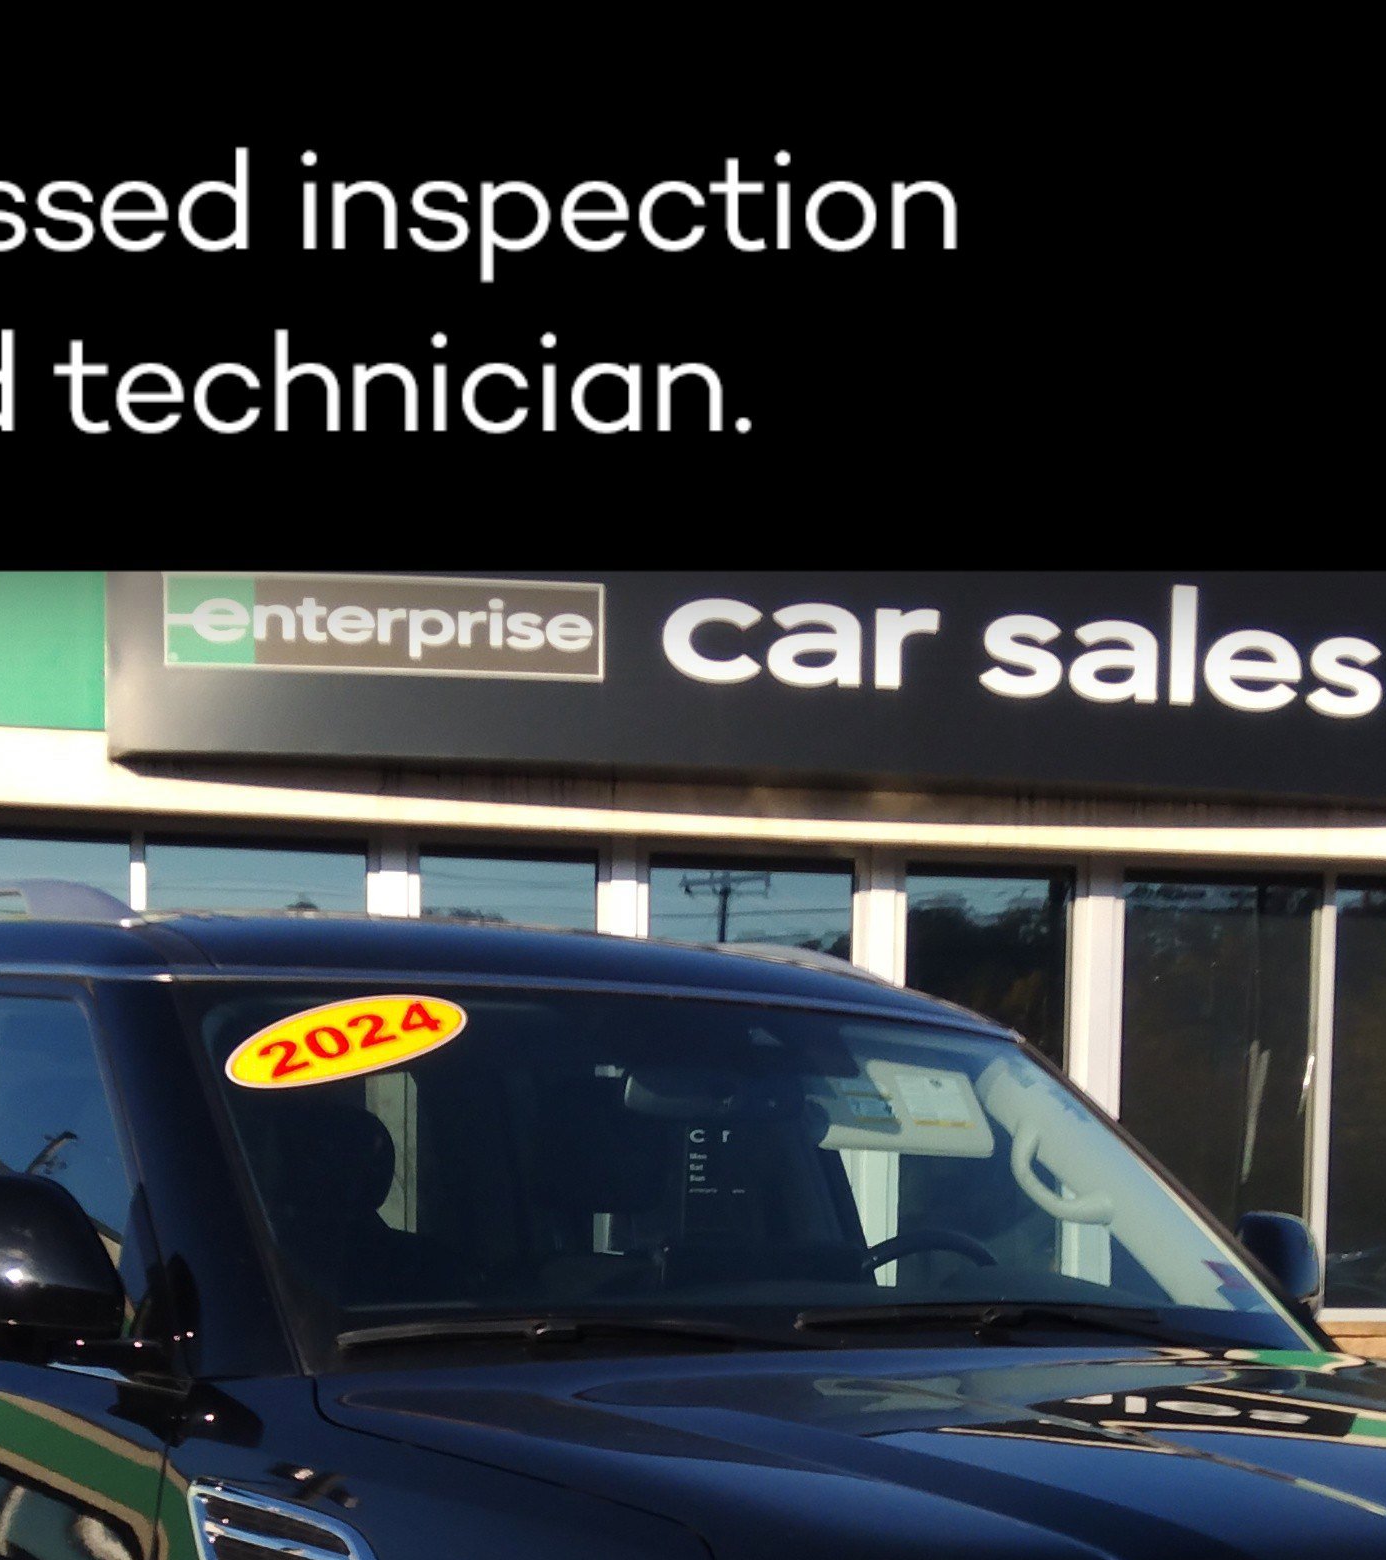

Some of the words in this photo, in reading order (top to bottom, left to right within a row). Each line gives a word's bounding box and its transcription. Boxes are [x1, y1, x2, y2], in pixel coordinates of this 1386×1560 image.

[191, 597, 595, 660] enterprise
[662, 597, 941, 692] car
[979, 584, 1385, 718] sales
[258, 1000, 443, 1079] 2024
